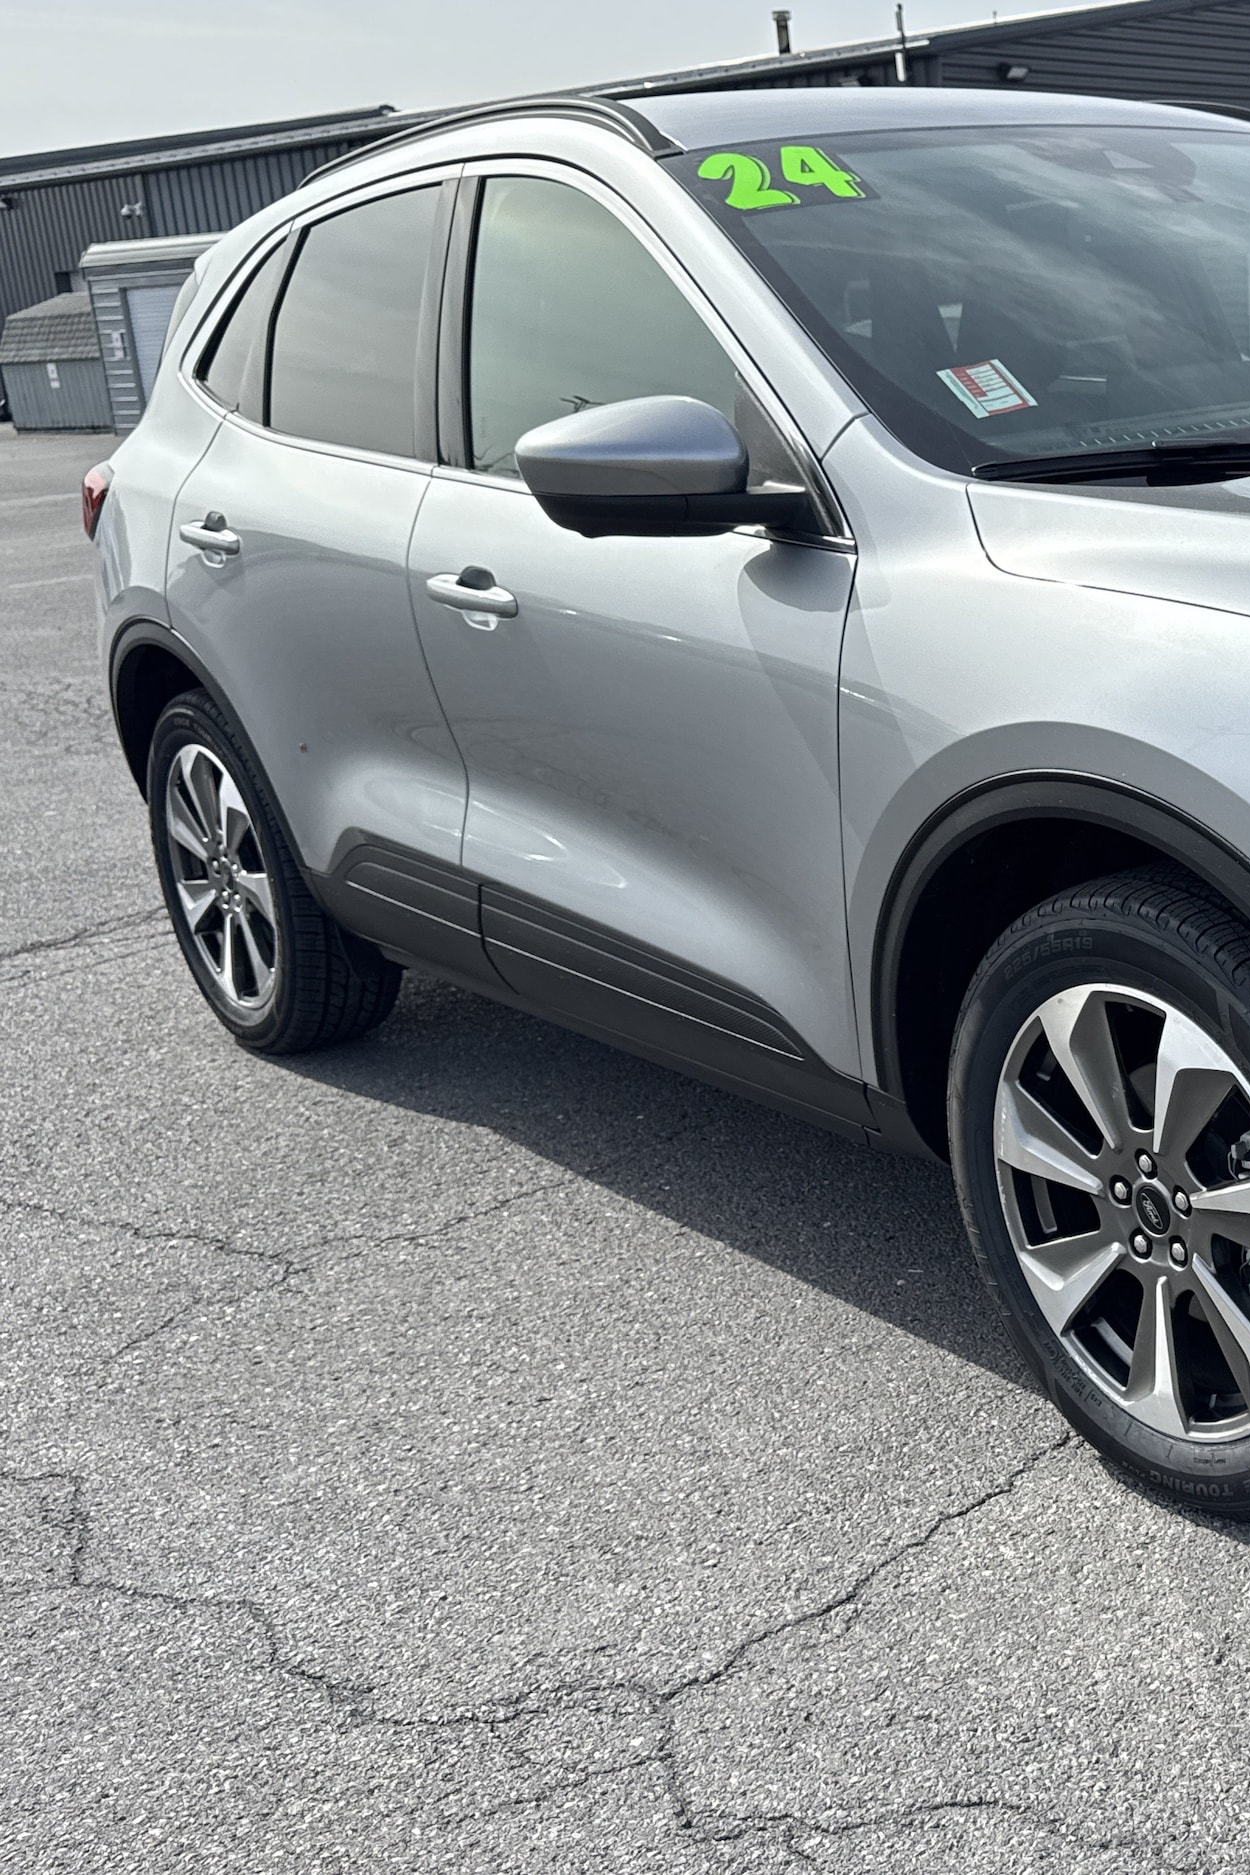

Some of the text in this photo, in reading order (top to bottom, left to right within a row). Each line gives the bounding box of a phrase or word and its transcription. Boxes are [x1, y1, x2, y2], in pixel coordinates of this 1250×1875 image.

[697, 146, 866, 210] 24
[1003, 934, 1094, 981] 225/55R19
[1142, 1199, 1160, 1224] Ford
[1148, 1468, 1234, 1498] TOURING
